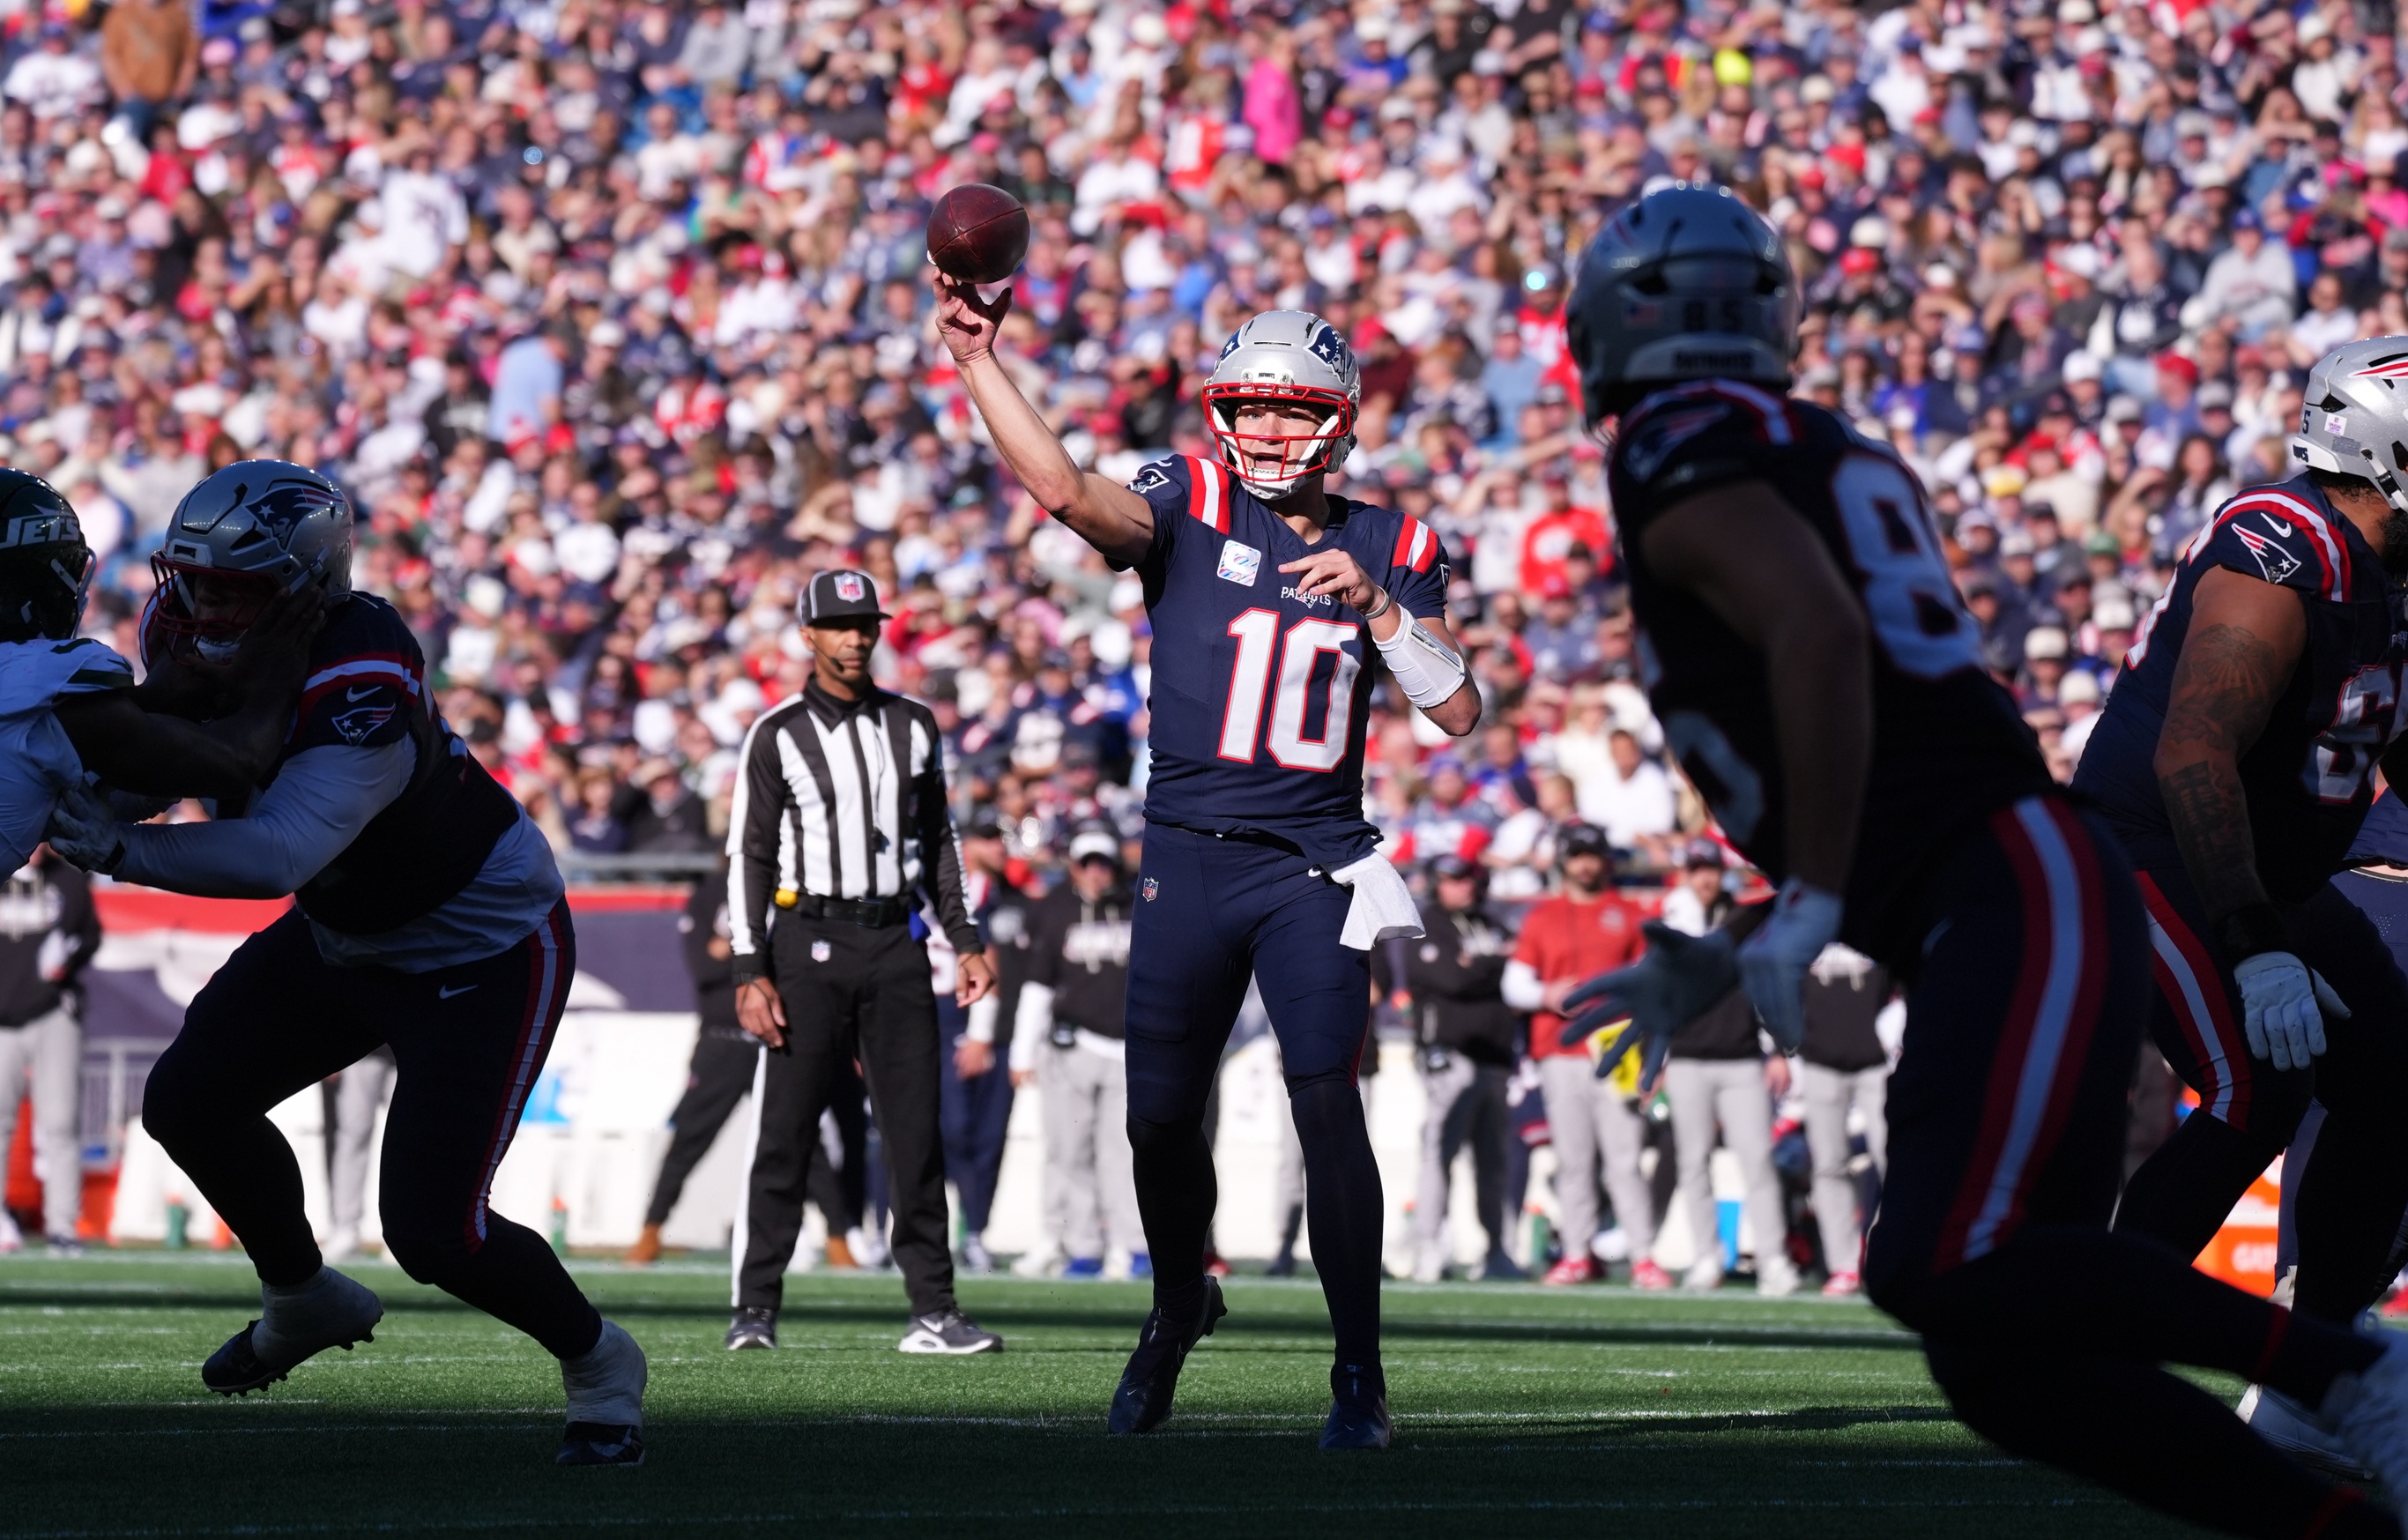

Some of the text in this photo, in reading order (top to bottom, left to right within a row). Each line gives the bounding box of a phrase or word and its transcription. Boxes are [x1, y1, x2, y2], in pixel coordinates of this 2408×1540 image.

[2302, 409, 2311, 435] 5
[0, 516, 78, 550] JETS
[1216, 606, 1364, 773] 10
